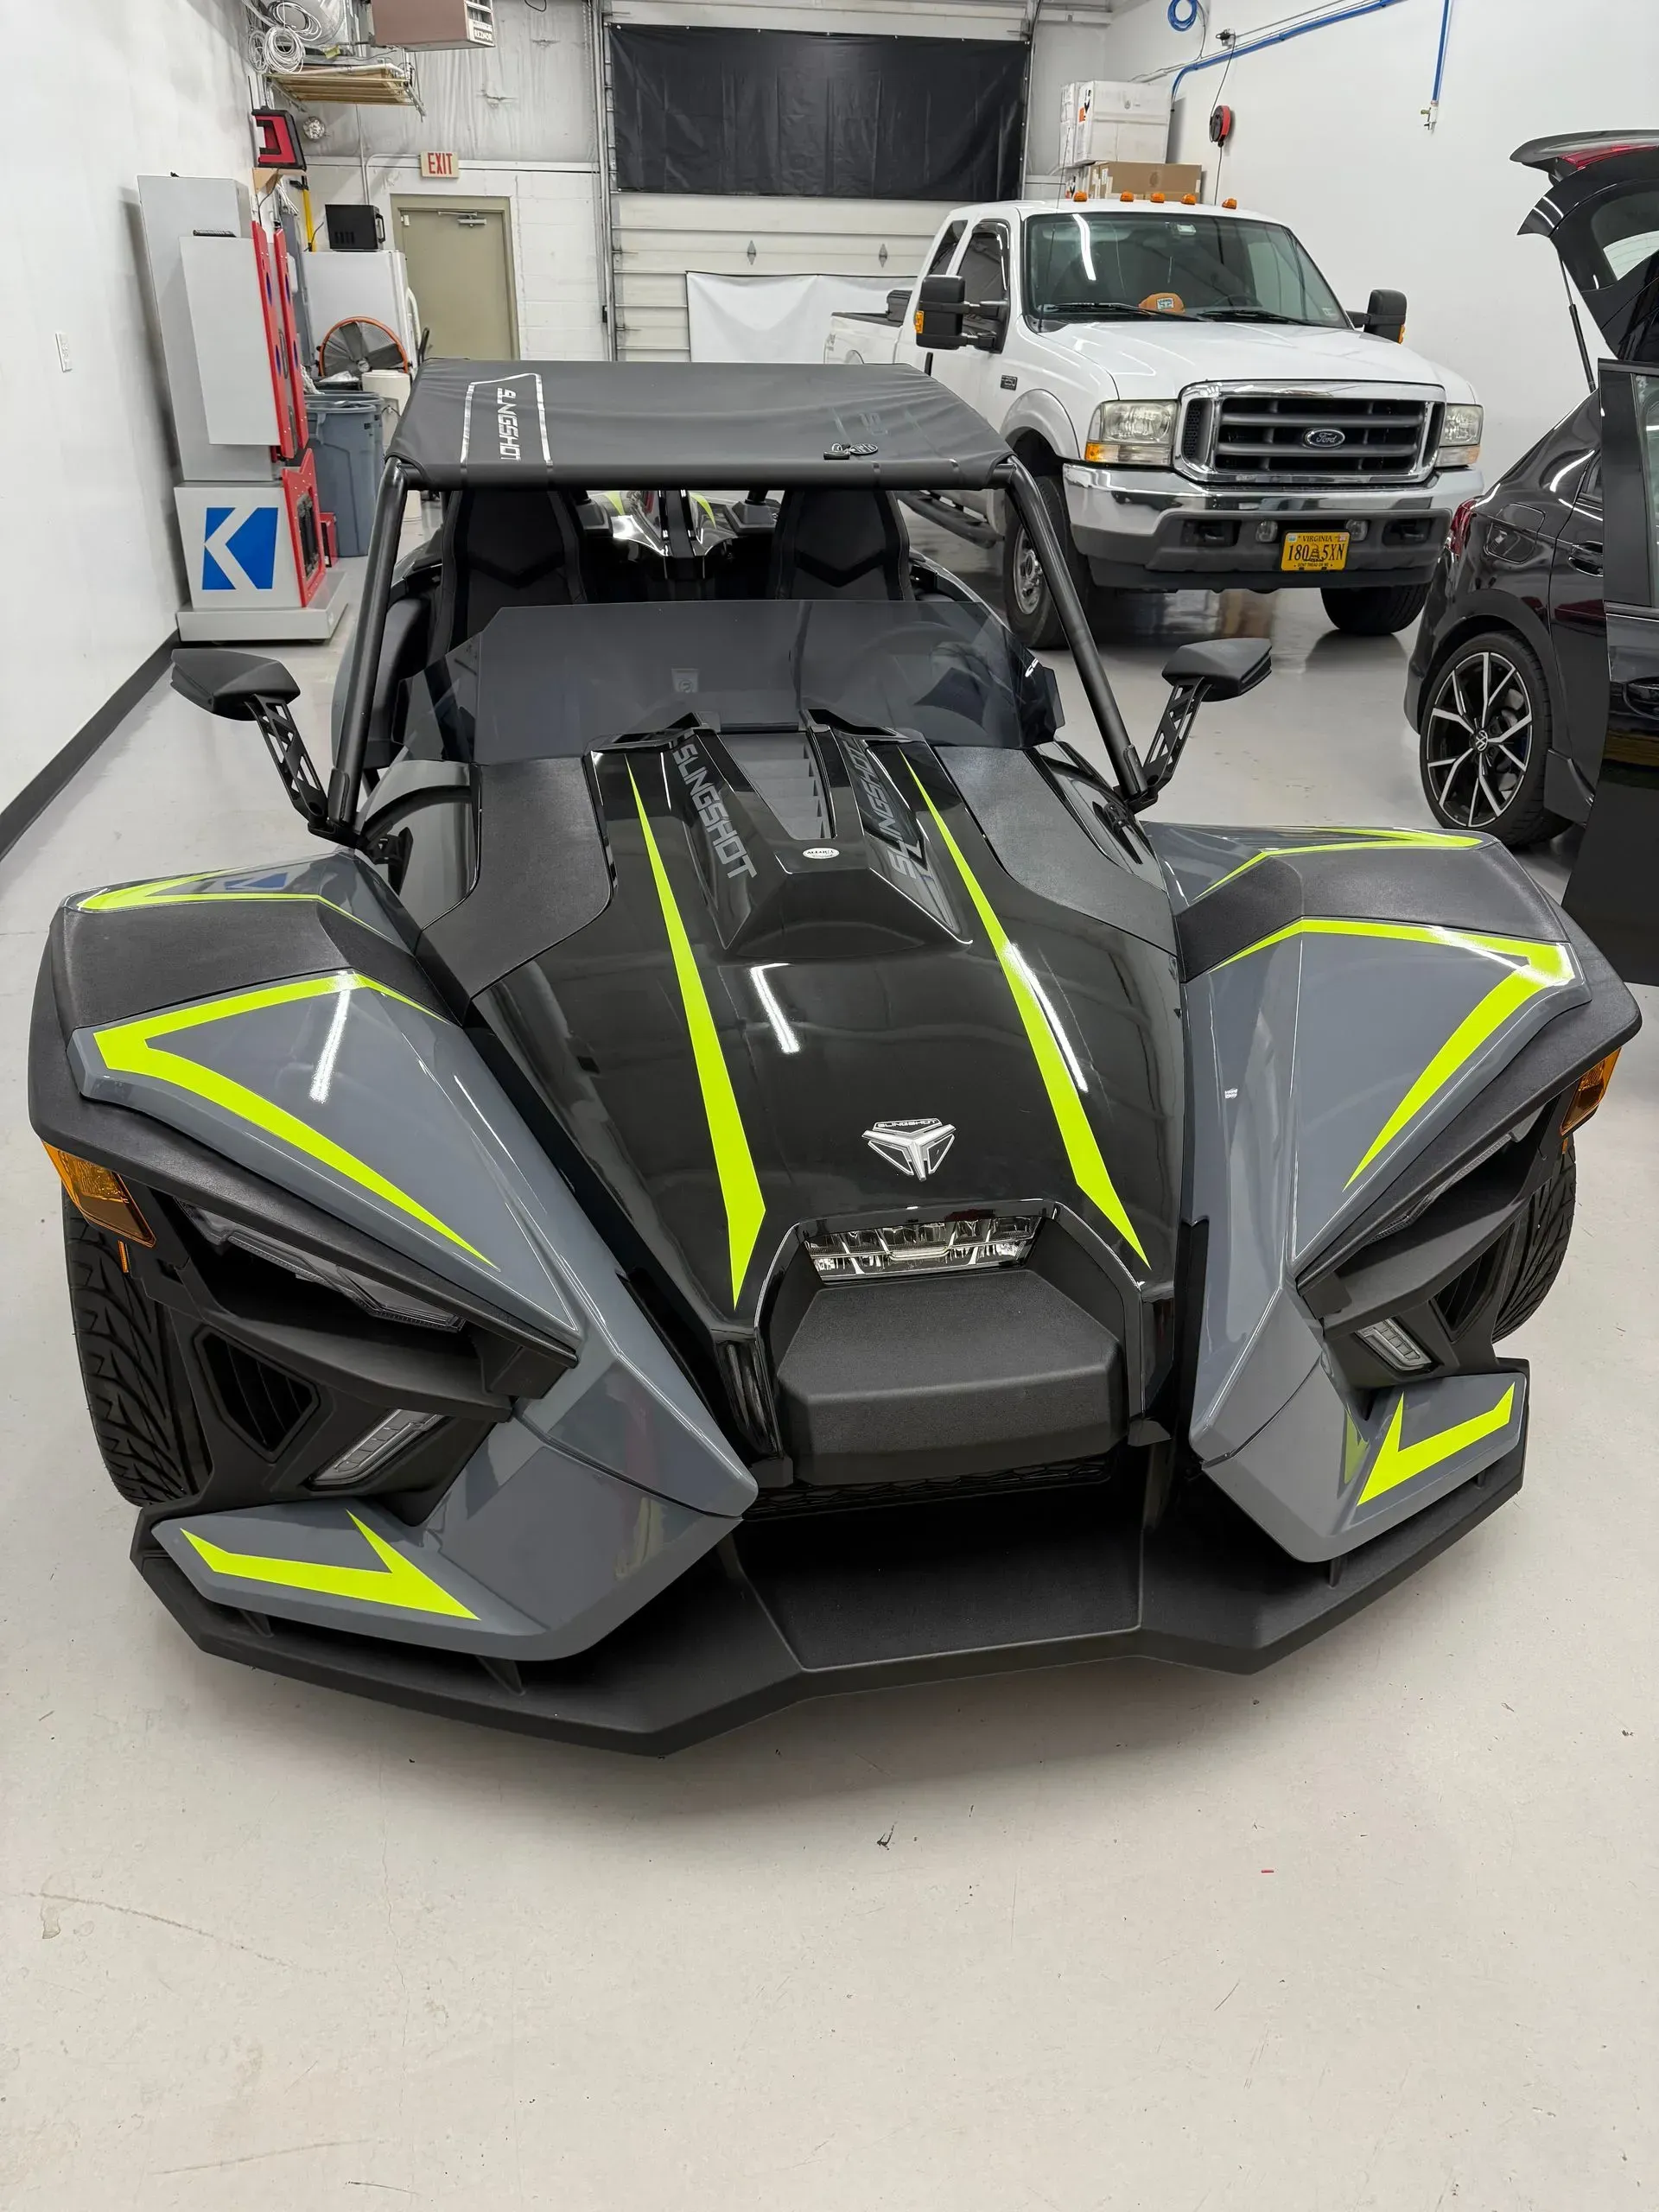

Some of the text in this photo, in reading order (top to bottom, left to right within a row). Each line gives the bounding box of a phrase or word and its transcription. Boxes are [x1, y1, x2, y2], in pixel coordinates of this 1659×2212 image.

[428, 152, 453, 175] EXIT
[497, 387, 522, 461] SLINGSHOT
[1316, 433, 1338, 442] Ford
[1287, 543, 1345, 561] 180 5XN
[672, 744, 757, 878] SLINGSHOT
[842, 738, 917, 880] SLINGSHOT
